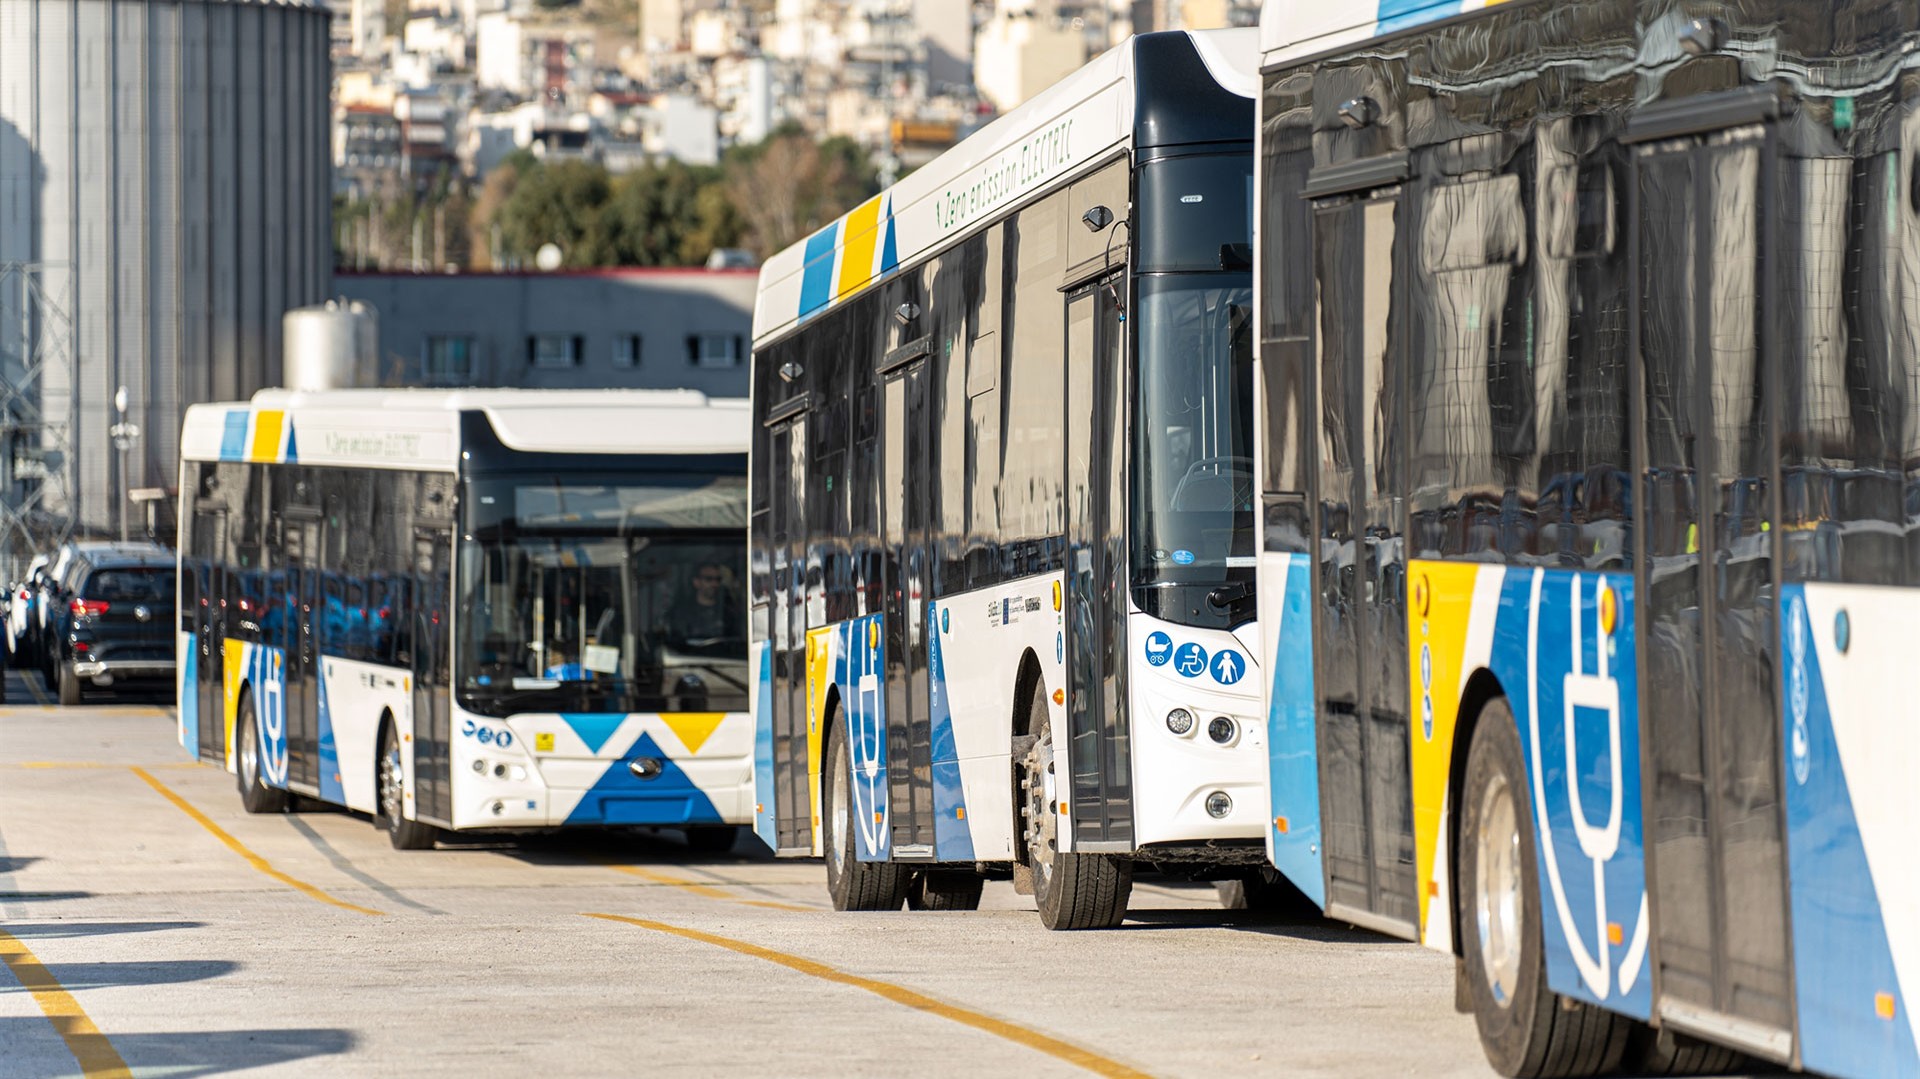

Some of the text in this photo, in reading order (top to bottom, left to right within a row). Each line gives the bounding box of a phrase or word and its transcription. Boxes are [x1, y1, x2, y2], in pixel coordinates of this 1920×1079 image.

[944, 118, 1073, 228] Zero emission ELECTRIC
